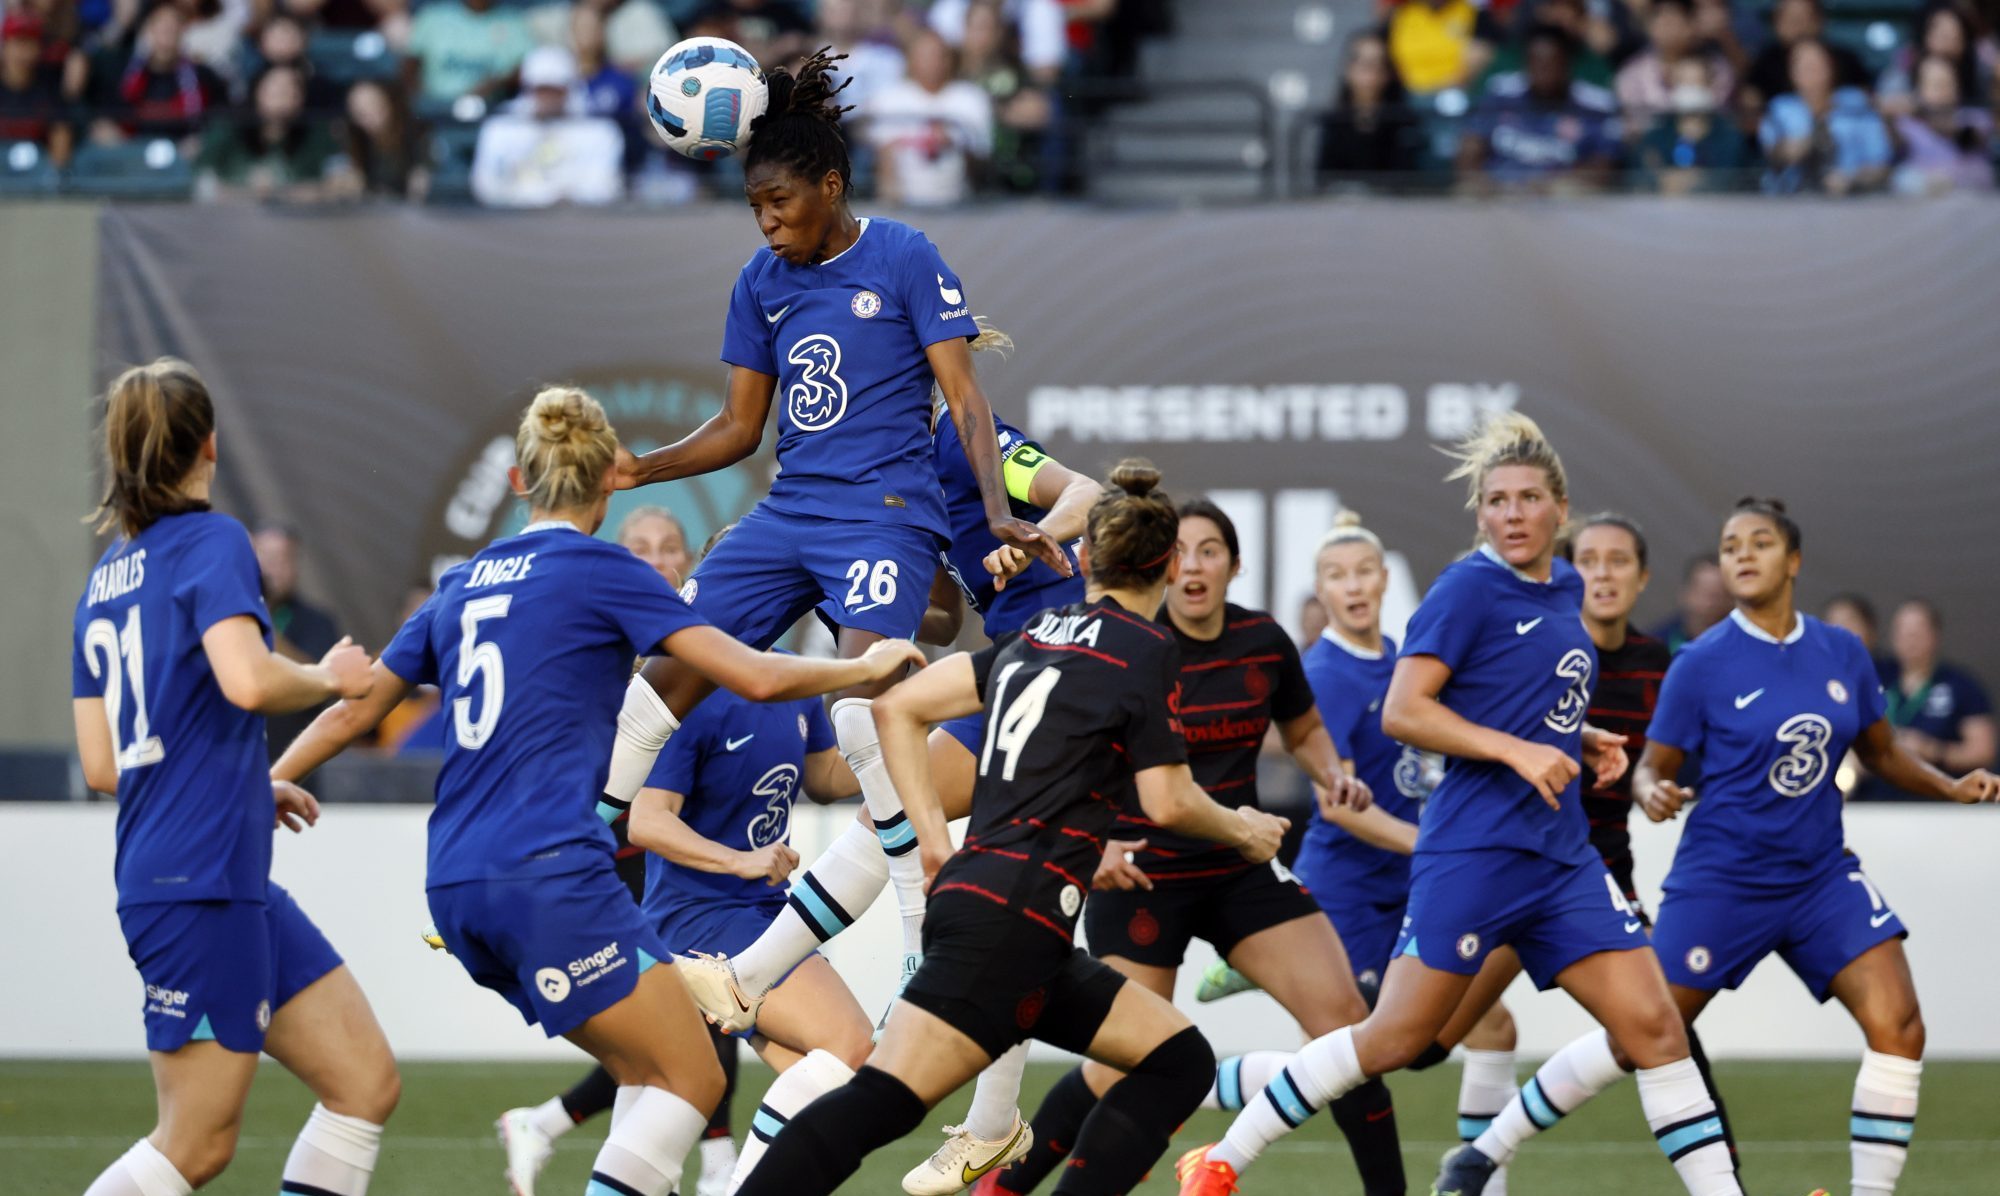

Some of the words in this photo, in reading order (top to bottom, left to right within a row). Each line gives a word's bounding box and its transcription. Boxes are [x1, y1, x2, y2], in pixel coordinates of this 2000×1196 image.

[788, 333, 848, 432] 3
[1028, 383, 1408, 441] PRESENTED
[1425, 382, 1520, 441] BY
[1012, 448, 1045, 468] C
[87, 548, 147, 608] CHARLES
[464, 552, 537, 588] INGLE
[845, 559, 899, 606] 26
[84, 604, 166, 778] 21
[453, 593, 513, 750] 5
[979, 660, 1062, 782] 14
[1768, 712, 1832, 798] 3
[568, 941, 620, 977] Singer
